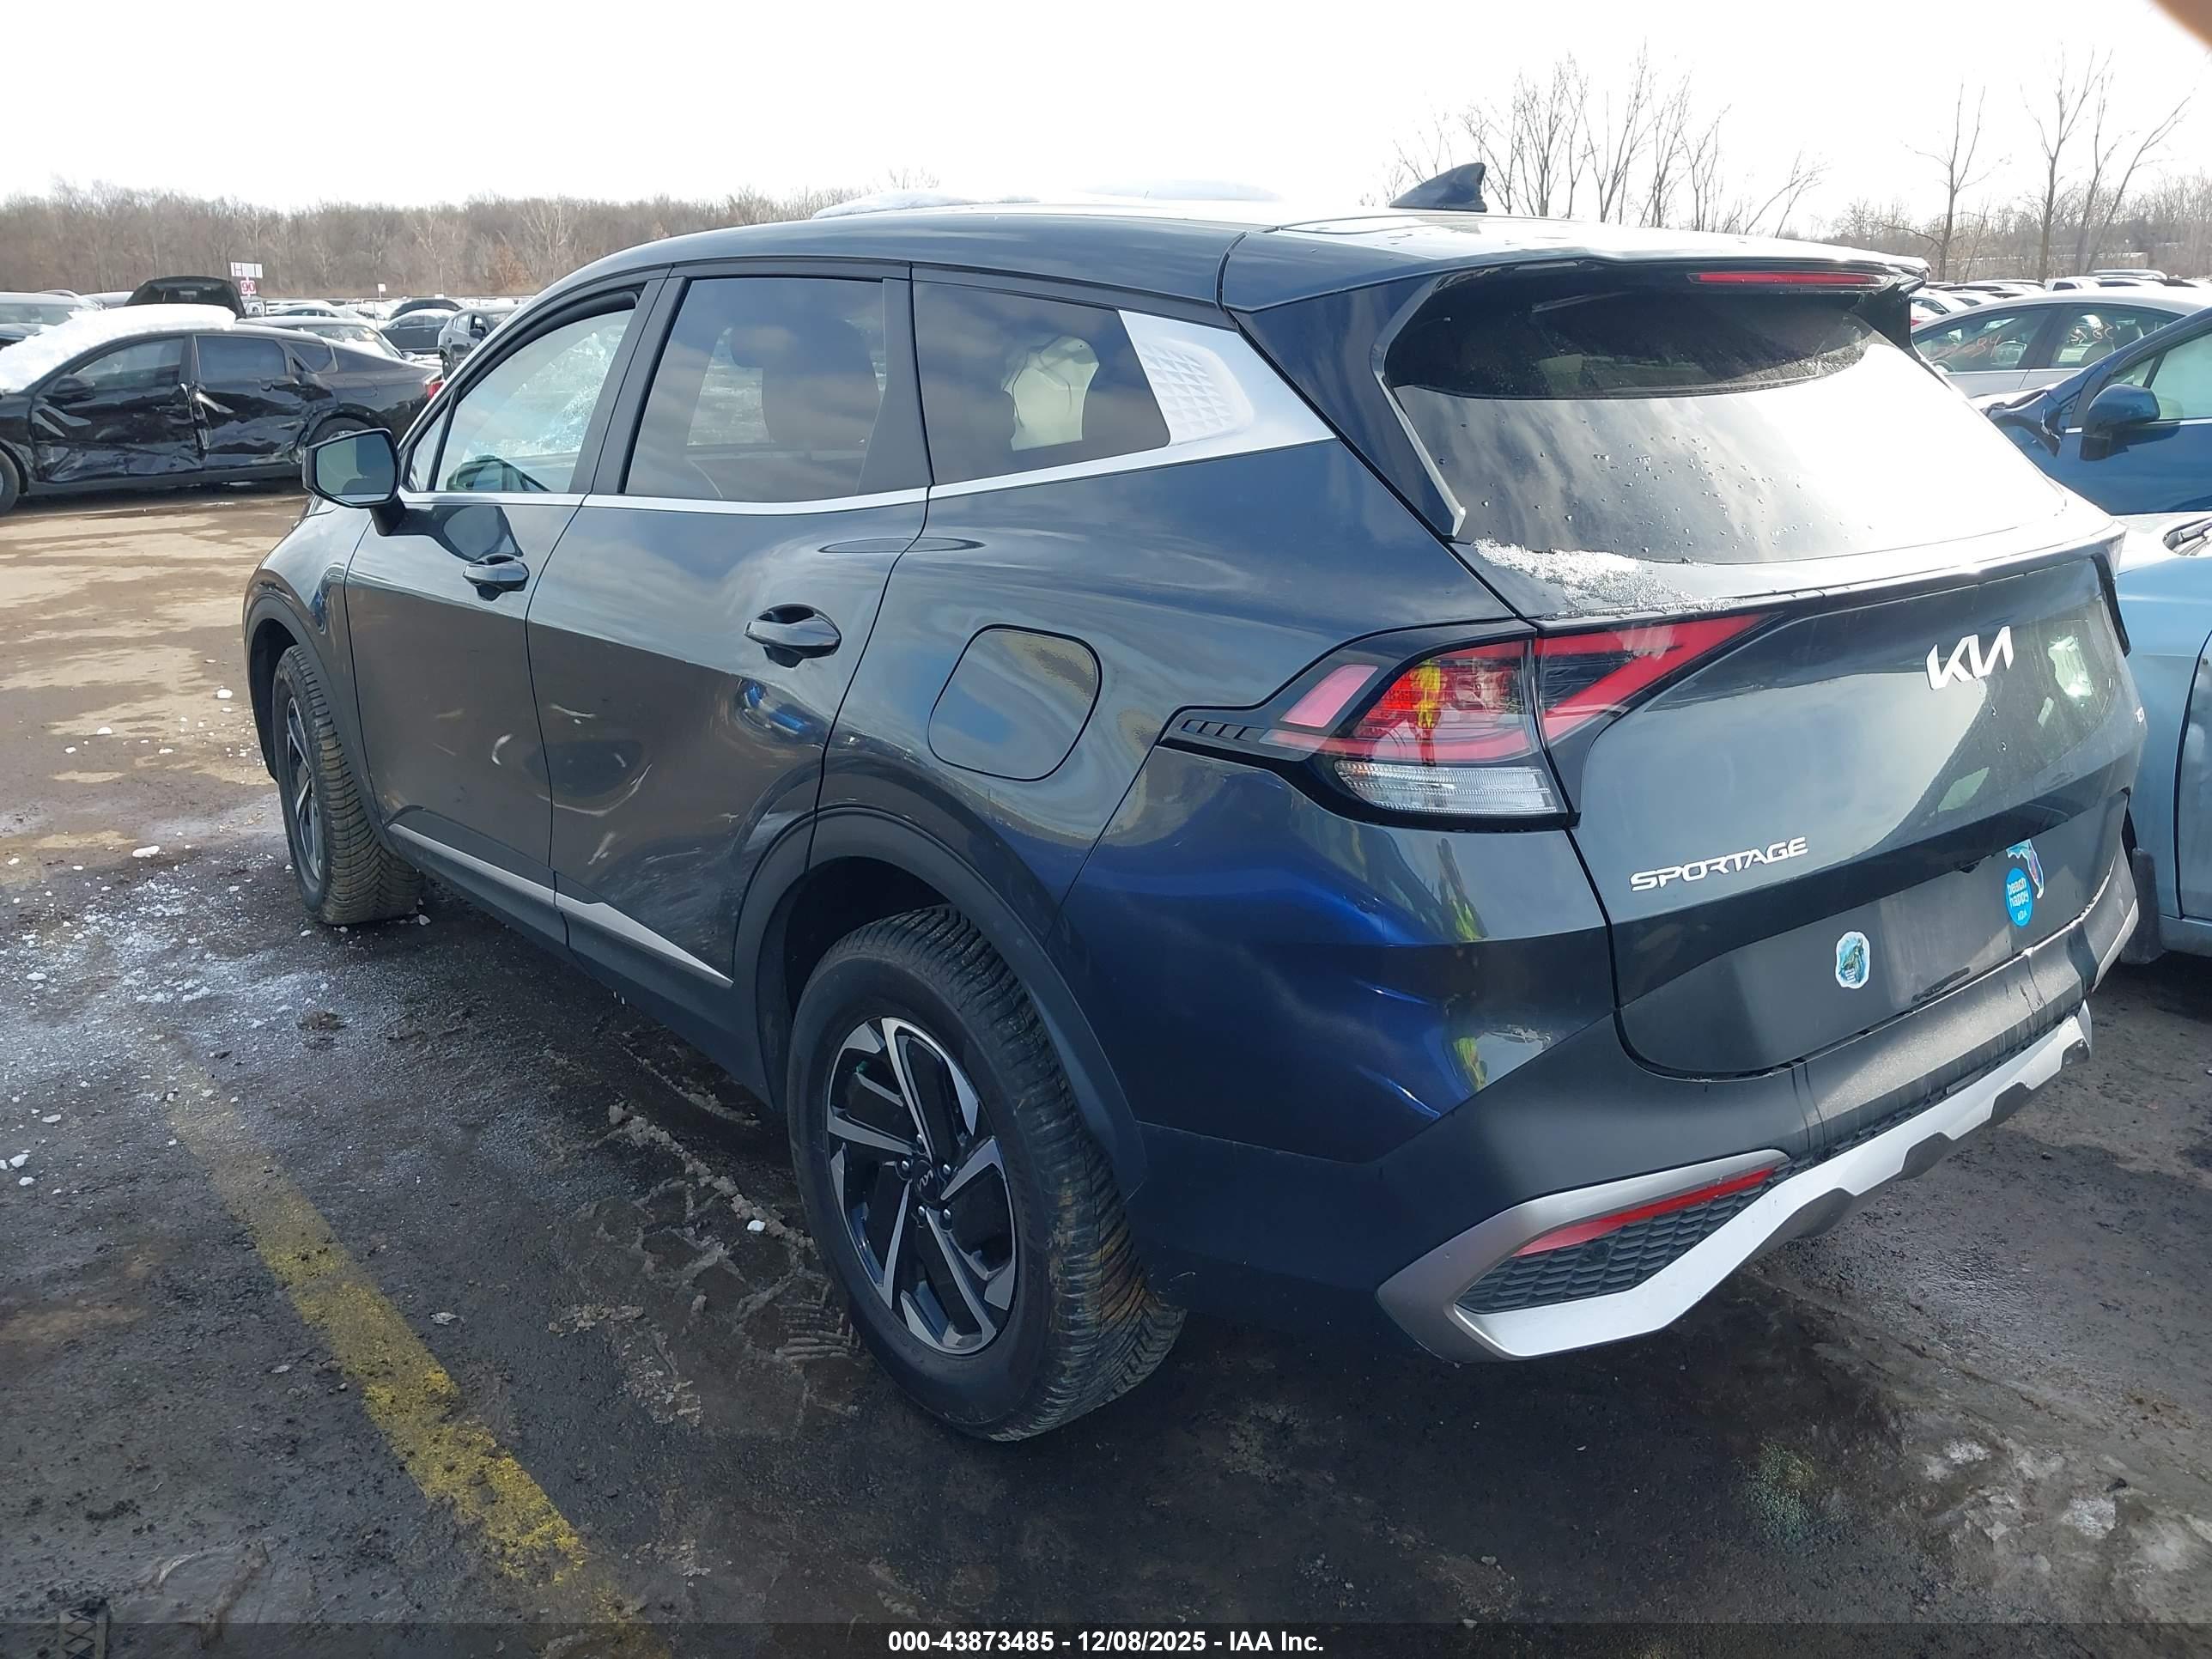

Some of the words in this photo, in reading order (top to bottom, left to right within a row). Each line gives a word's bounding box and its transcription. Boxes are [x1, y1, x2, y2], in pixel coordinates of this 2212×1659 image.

[242, 282, 256, 292] 90
[1629, 836, 1809, 893] SPORTAGE
[2006, 877, 2027, 895] beach
[2009, 888, 2029, 908] happy
